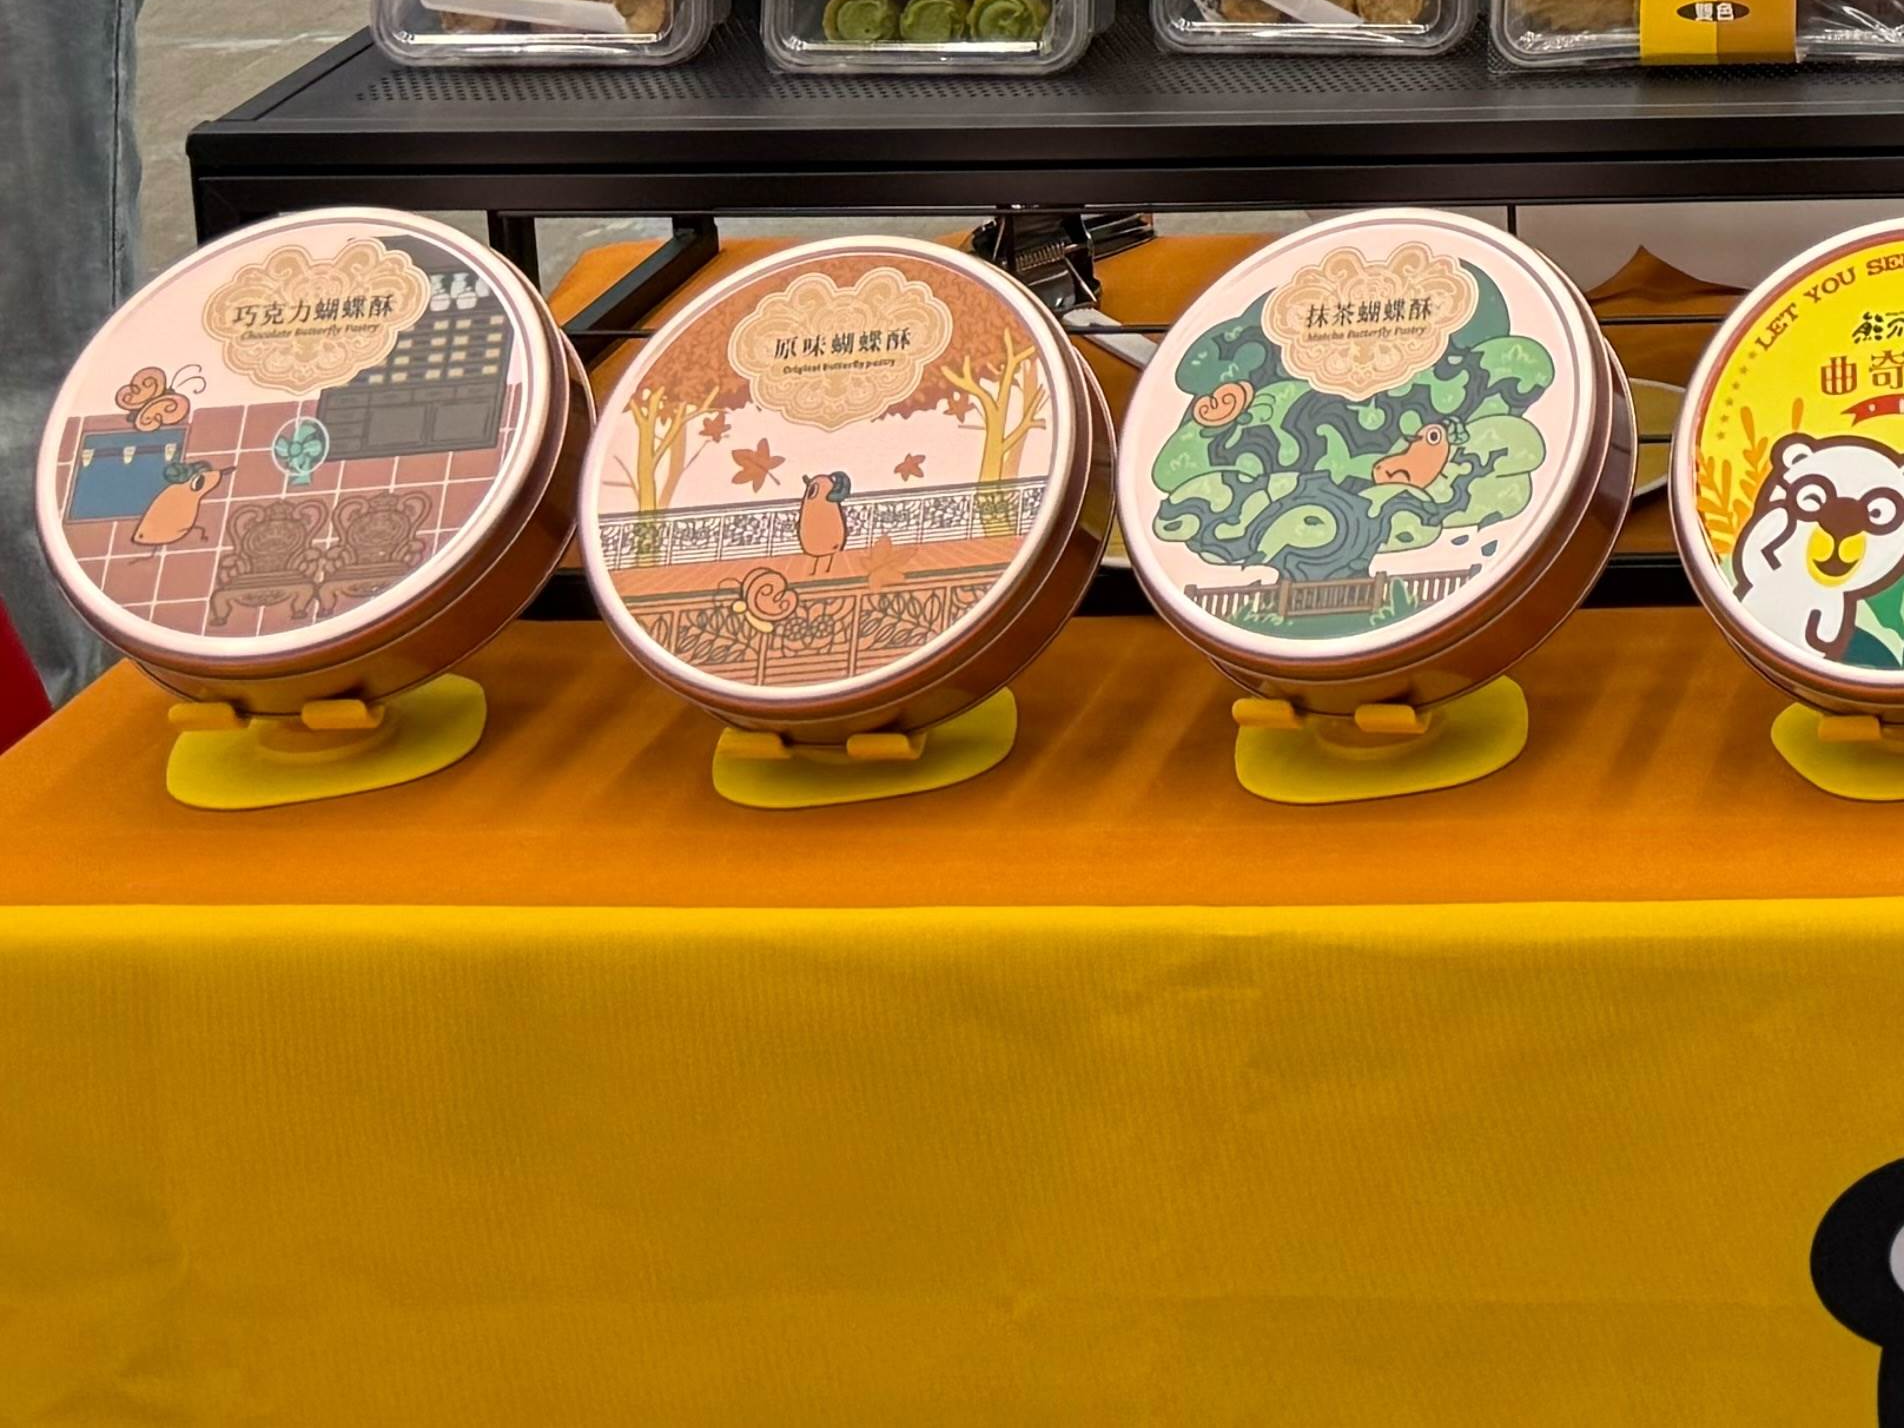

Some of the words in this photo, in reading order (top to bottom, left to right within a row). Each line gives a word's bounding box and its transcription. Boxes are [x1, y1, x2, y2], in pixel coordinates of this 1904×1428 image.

[232, 294, 395, 328] 巧克力蝴蝶酥
[1305, 296, 1432, 329] 抹茶蝴蝶酥
[1754, 302, 1798, 351] LET
[1803, 267, 1857, 304] YOU
[344, 323, 381, 334] Pastry
[774, 327, 911, 360] 原味蝴蝶酥
[1347, 326, 1392, 339] Butterfly
[1394, 326, 1428, 337] Pastry
